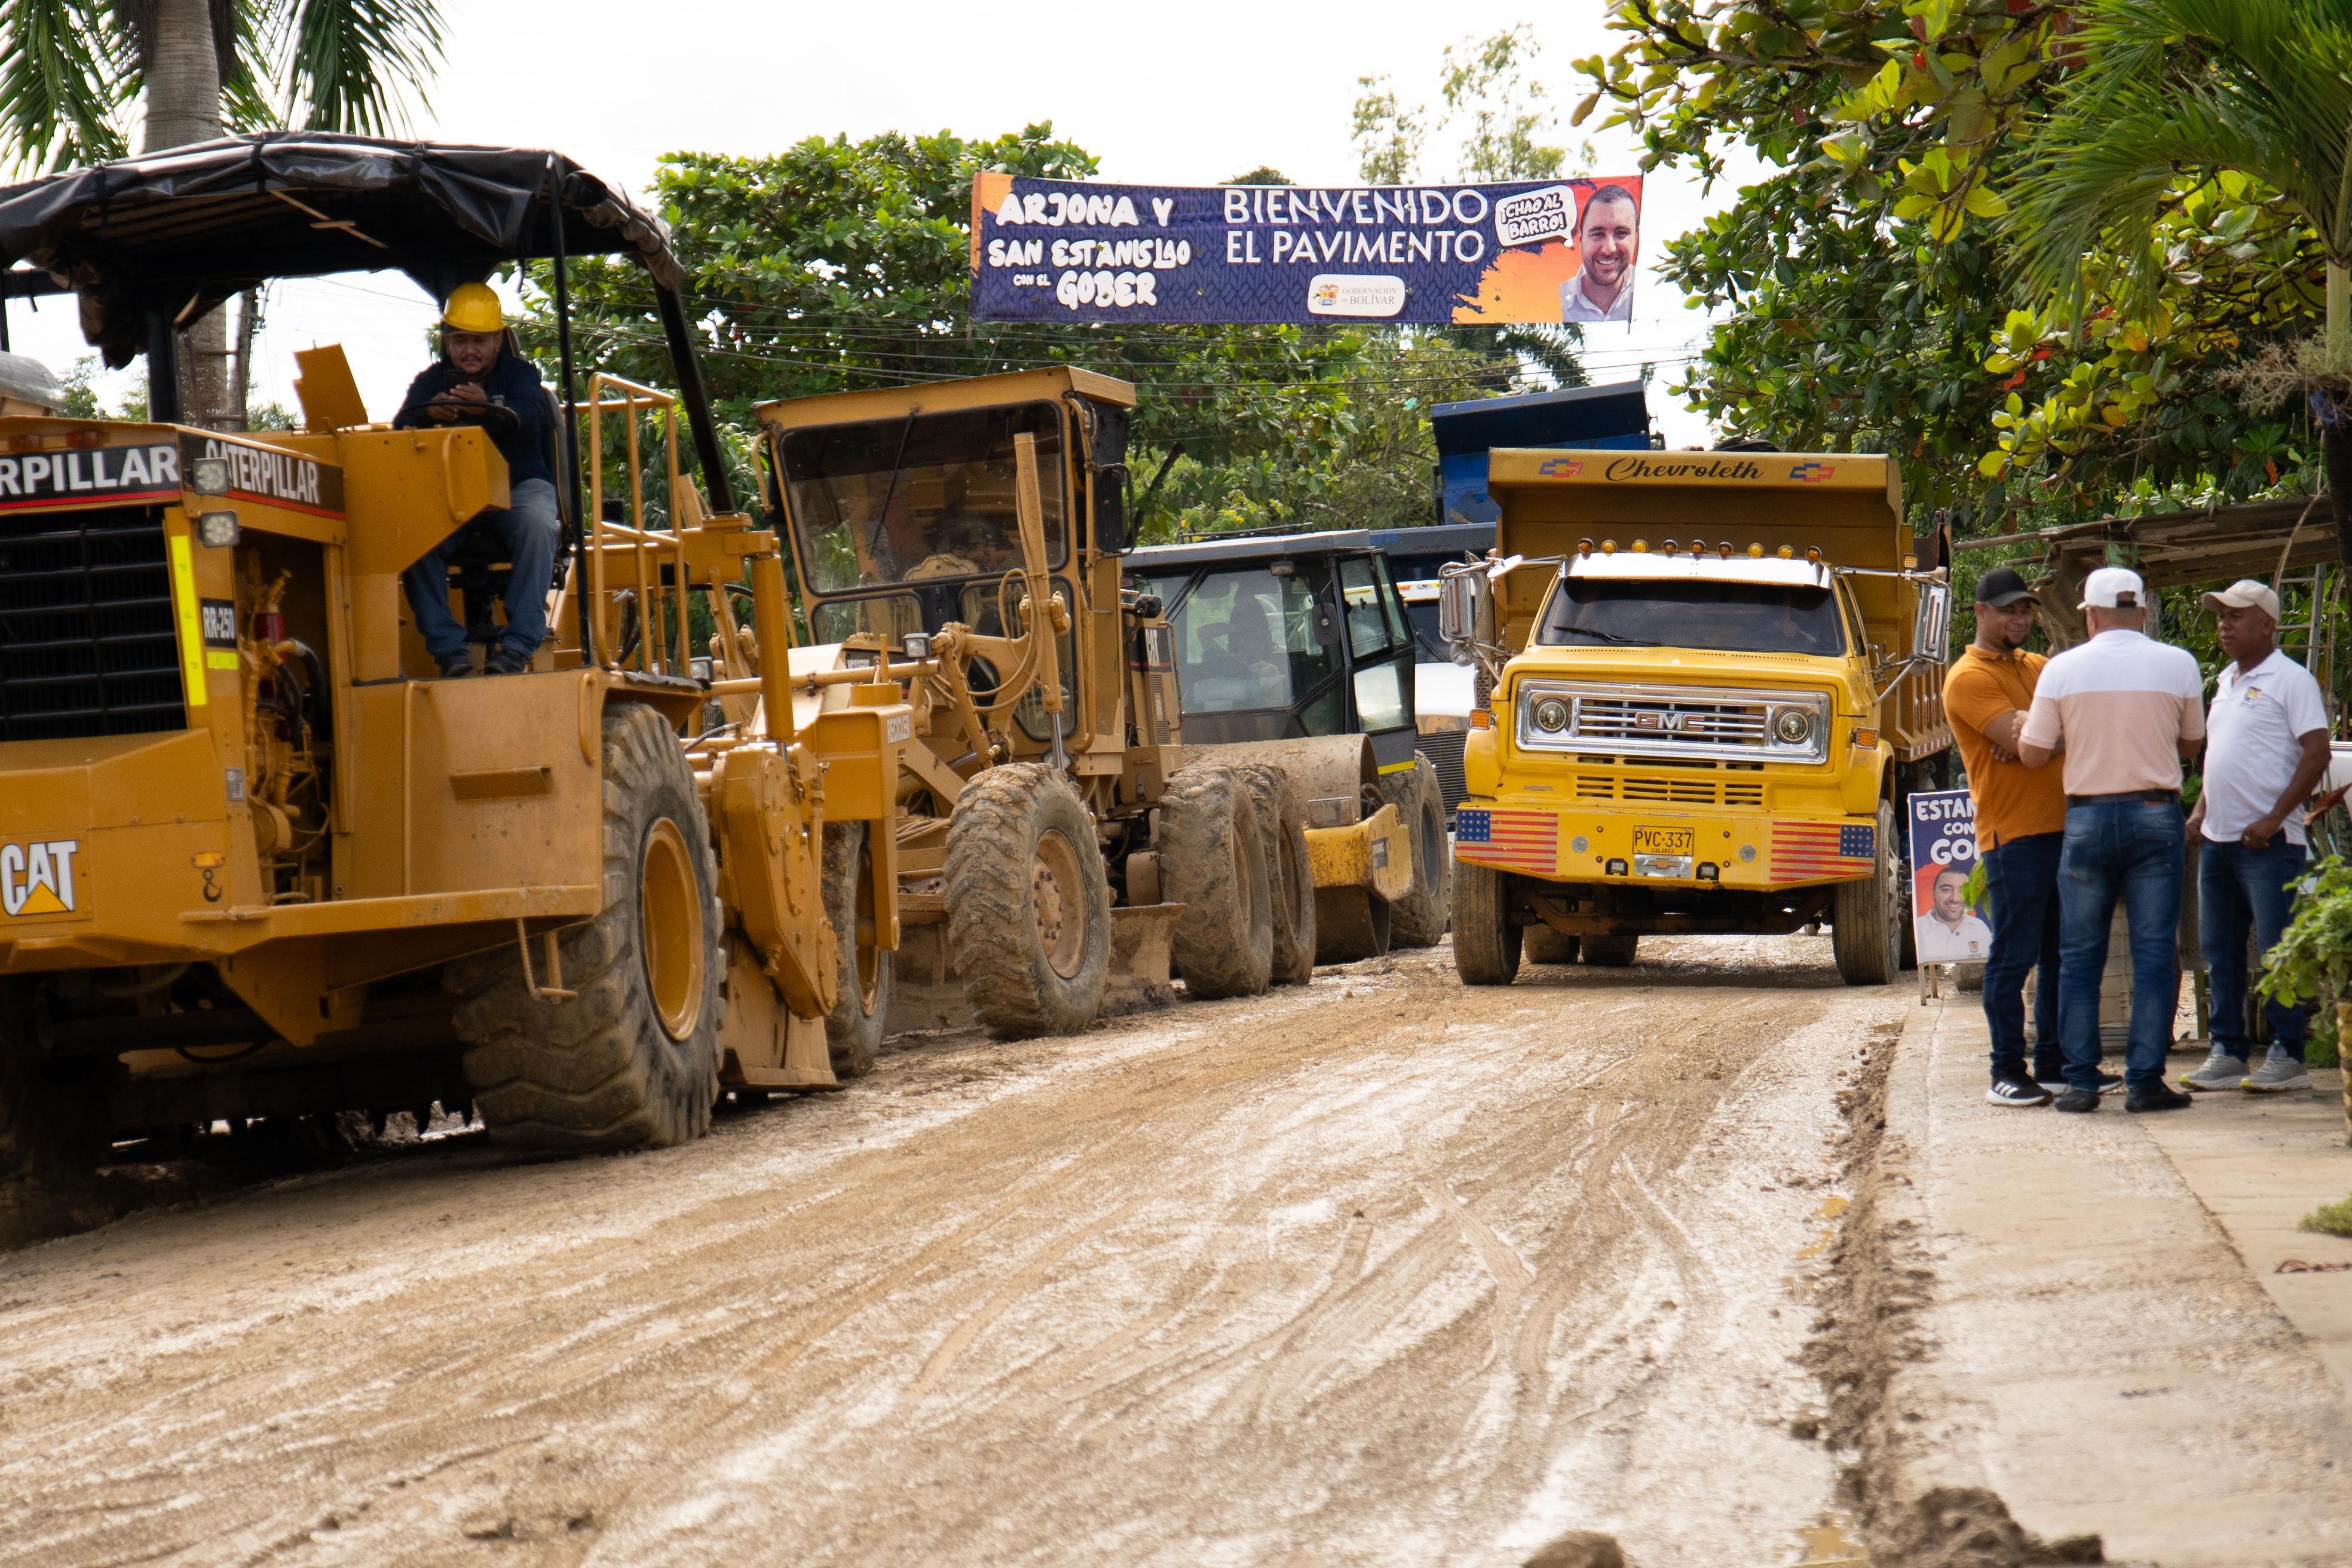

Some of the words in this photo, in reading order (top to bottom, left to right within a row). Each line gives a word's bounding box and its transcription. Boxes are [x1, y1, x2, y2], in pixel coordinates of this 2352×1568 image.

[995, 192, 1139, 227] ARJONA
[1152, 197, 1173, 226] Y
[1224, 189, 1488, 224] BIENVENIDO
[1544, 192, 1563, 211] AL
[1508, 212, 1567, 240] BARRO!
[988, 239, 1043, 268] SAN
[1051, 238, 1191, 269] ESTANISLAO
[1227, 231, 1261, 263] EL
[1273, 229, 1484, 263] PAVIMENTO
[1013, 274, 1034, 286] CON
[1036, 274, 1051, 286] EL
[1056, 270, 1157, 311] GOBER
[1342, 286, 1396, 294] GOBERNACIÓN
[1350, 295, 1395, 305] BOLÍVAR
[1604, 457, 1764, 481] Chevroleth
[1145, 628, 1160, 667] CAT
[1635, 712, 1705, 731] GMC
[1943, 822, 1976, 835] CON
[0, 840, 78, 915] CAT
